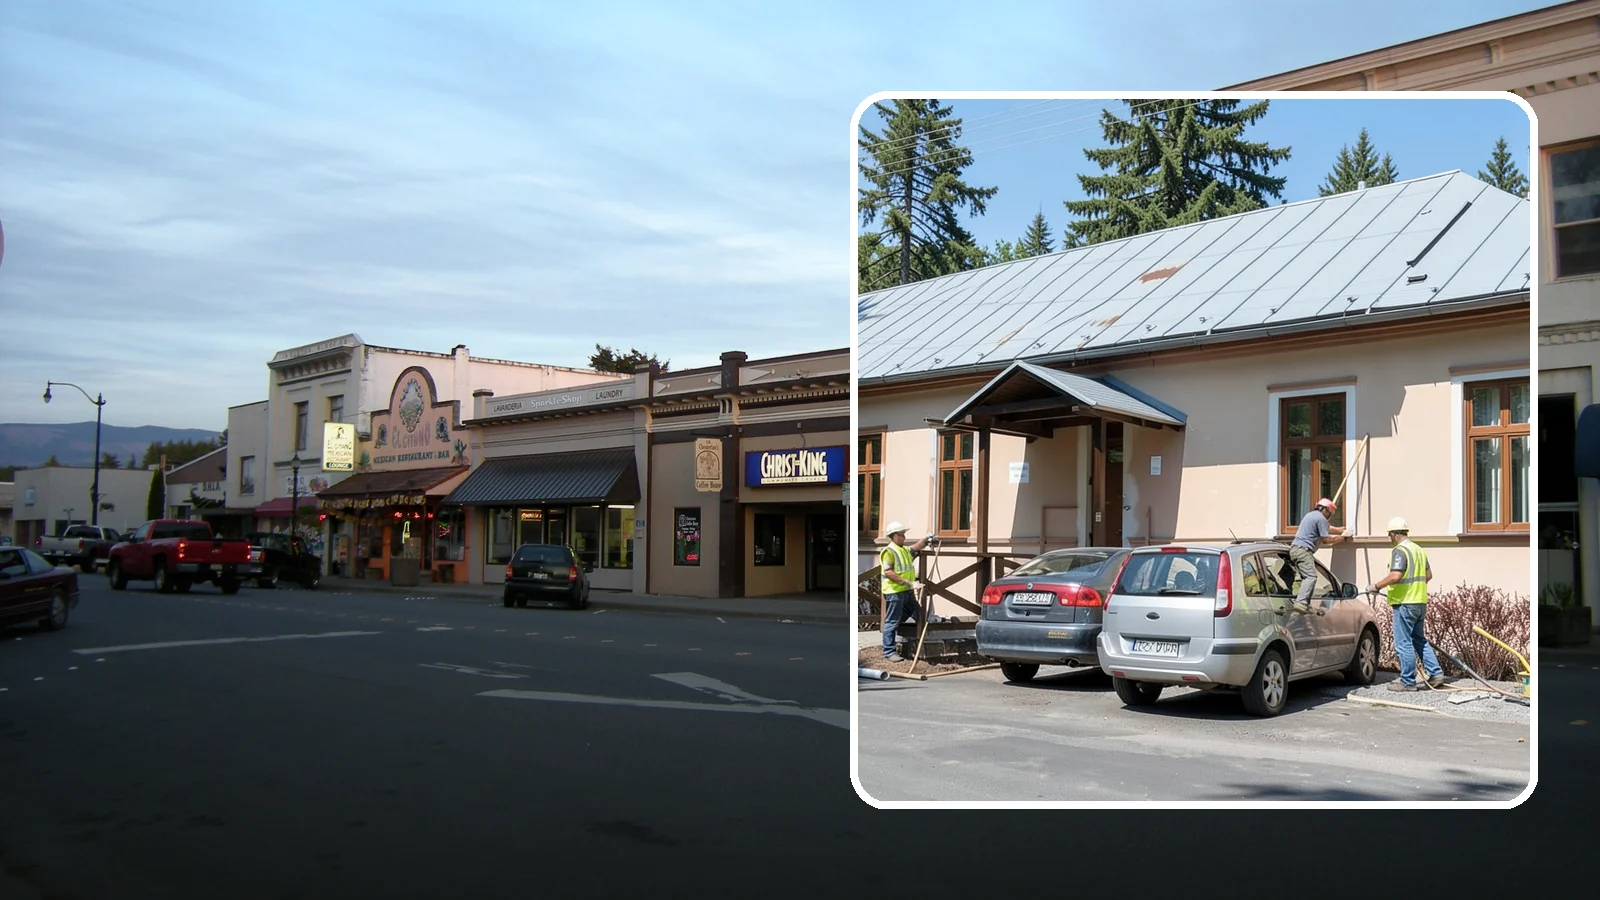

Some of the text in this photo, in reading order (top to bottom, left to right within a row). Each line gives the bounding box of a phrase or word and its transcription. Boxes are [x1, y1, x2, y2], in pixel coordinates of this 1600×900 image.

[595, 388, 623, 400] LAUNDRY
[493, 402, 522, 413] LAVANDERIA
[530, 394, 582, 409] Sparkle Shop
[373, 455, 396, 464] MEXICAN
[397, 451, 433, 462] RESTAURANT
[437, 450, 450, 459] BAR
[761, 452, 797, 478] CHRIST
[799, 450, 828, 476] KING
[697, 480, 721, 489] Coffee House
